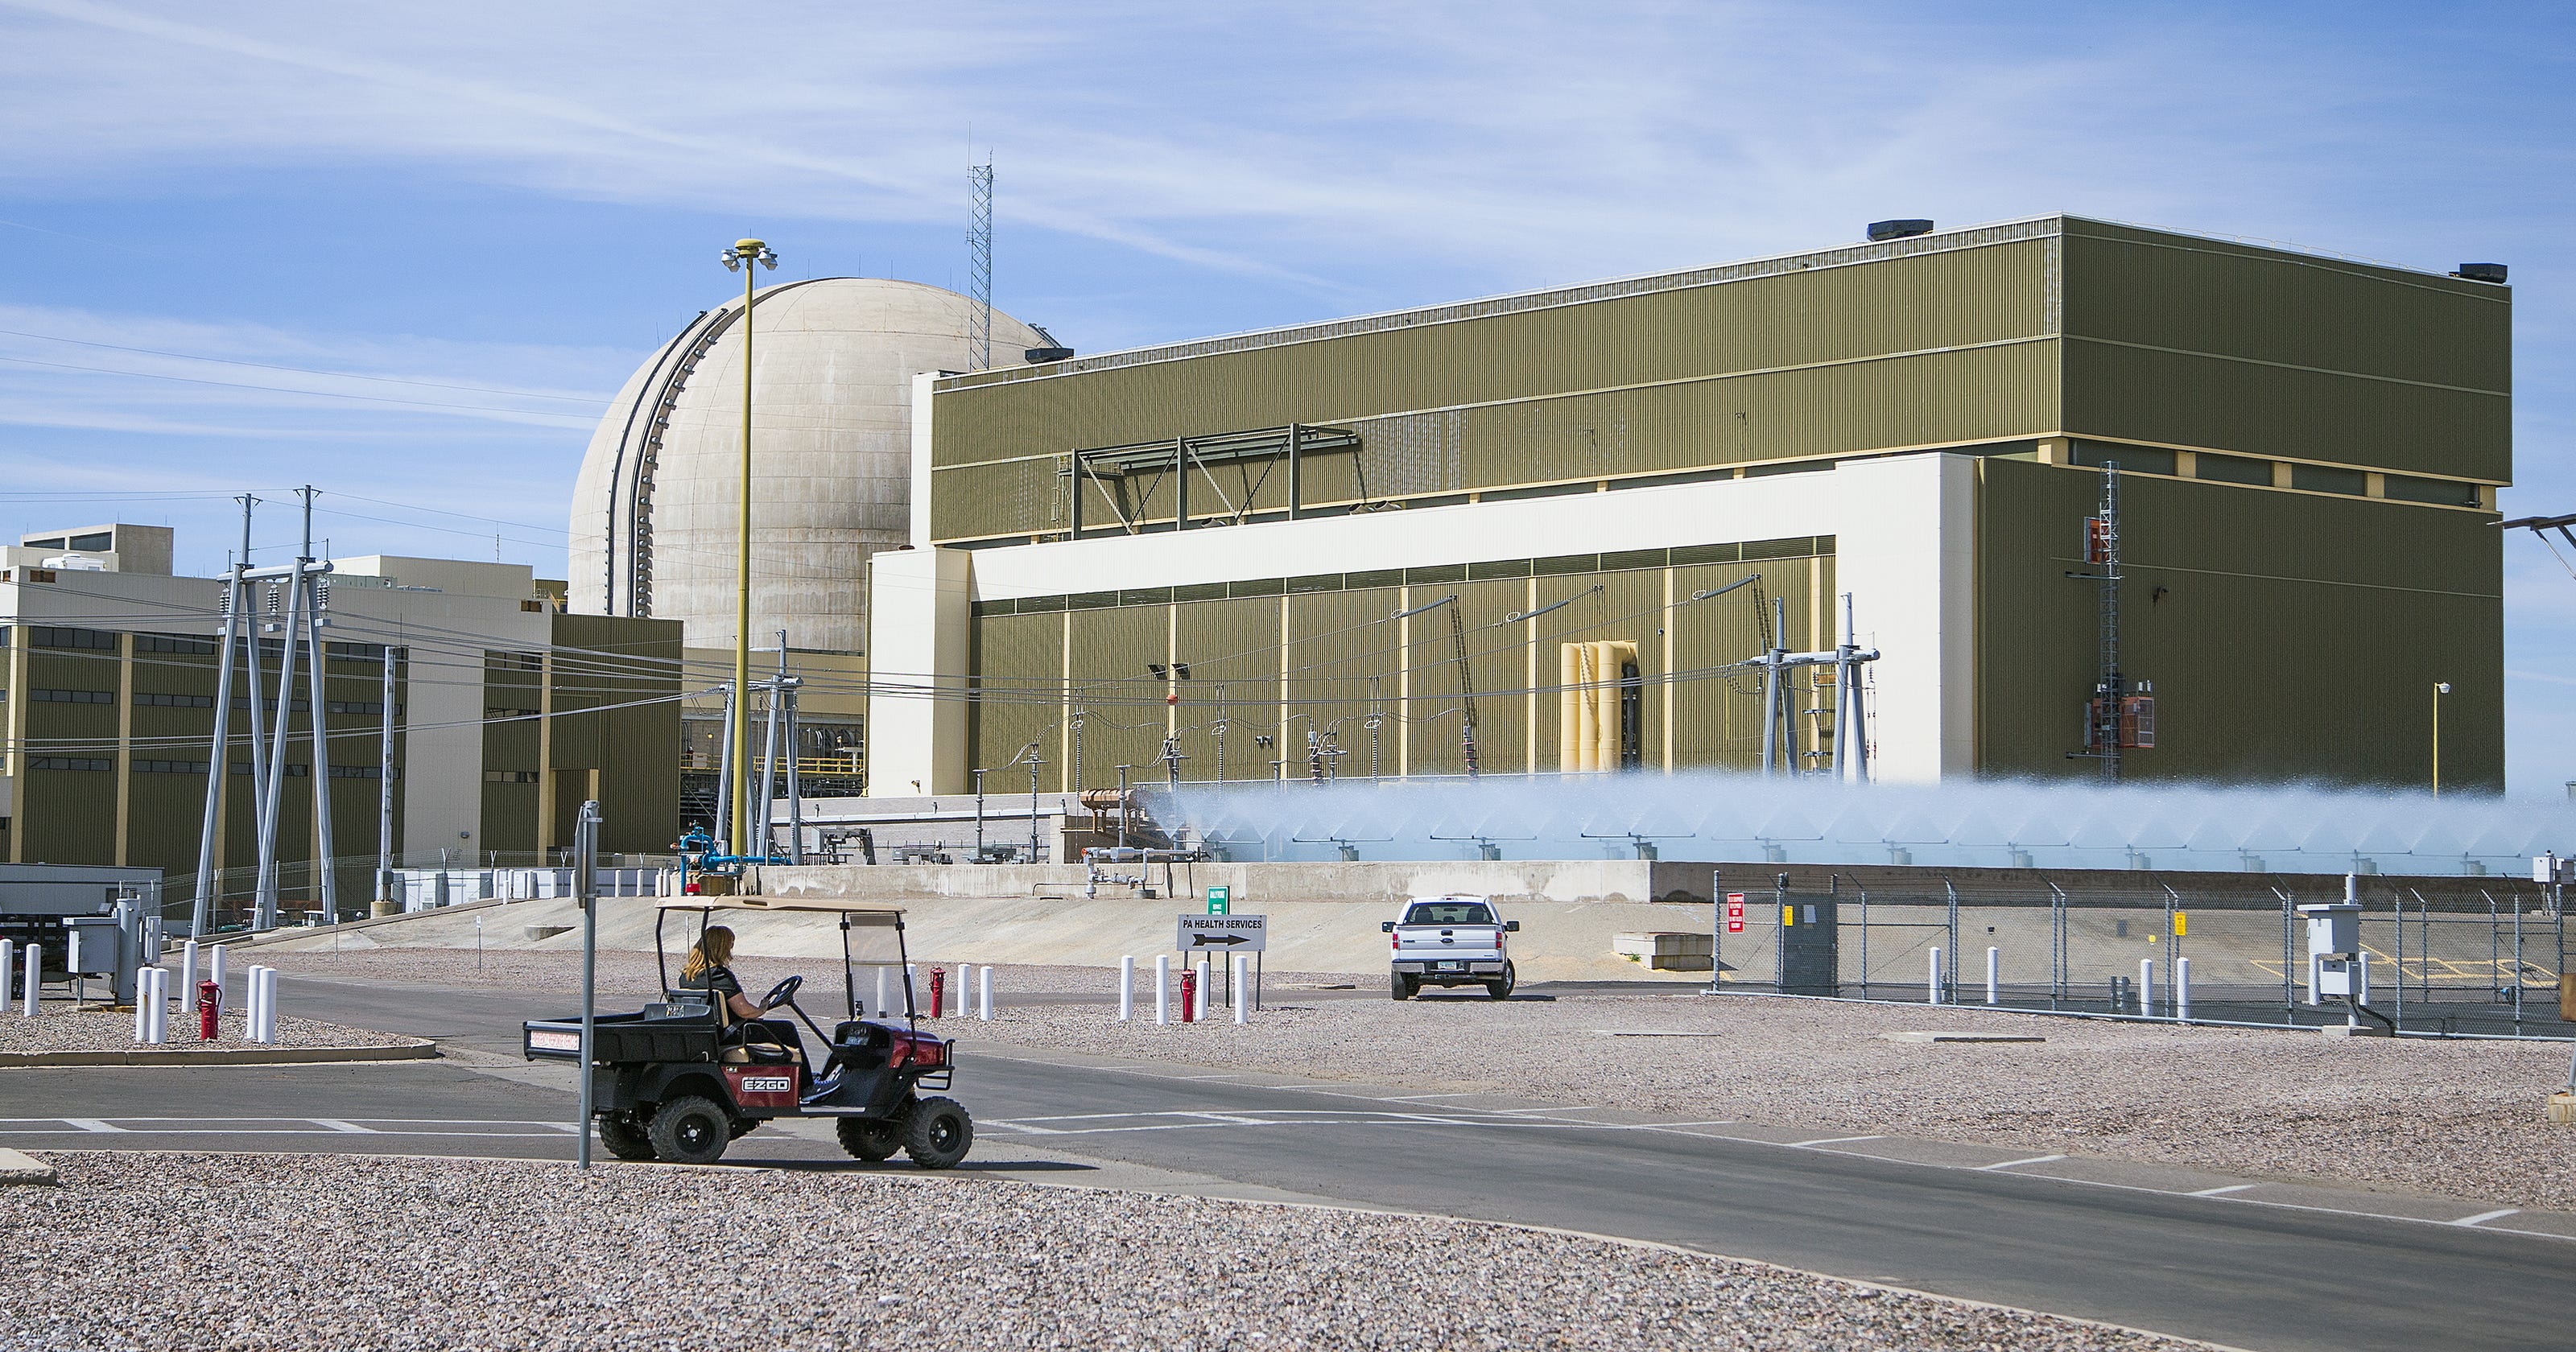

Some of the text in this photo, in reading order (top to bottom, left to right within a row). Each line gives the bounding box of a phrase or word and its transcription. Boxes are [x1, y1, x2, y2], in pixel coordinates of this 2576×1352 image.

[1183, 920, 1262, 929] PA HEALTH SERVICES
